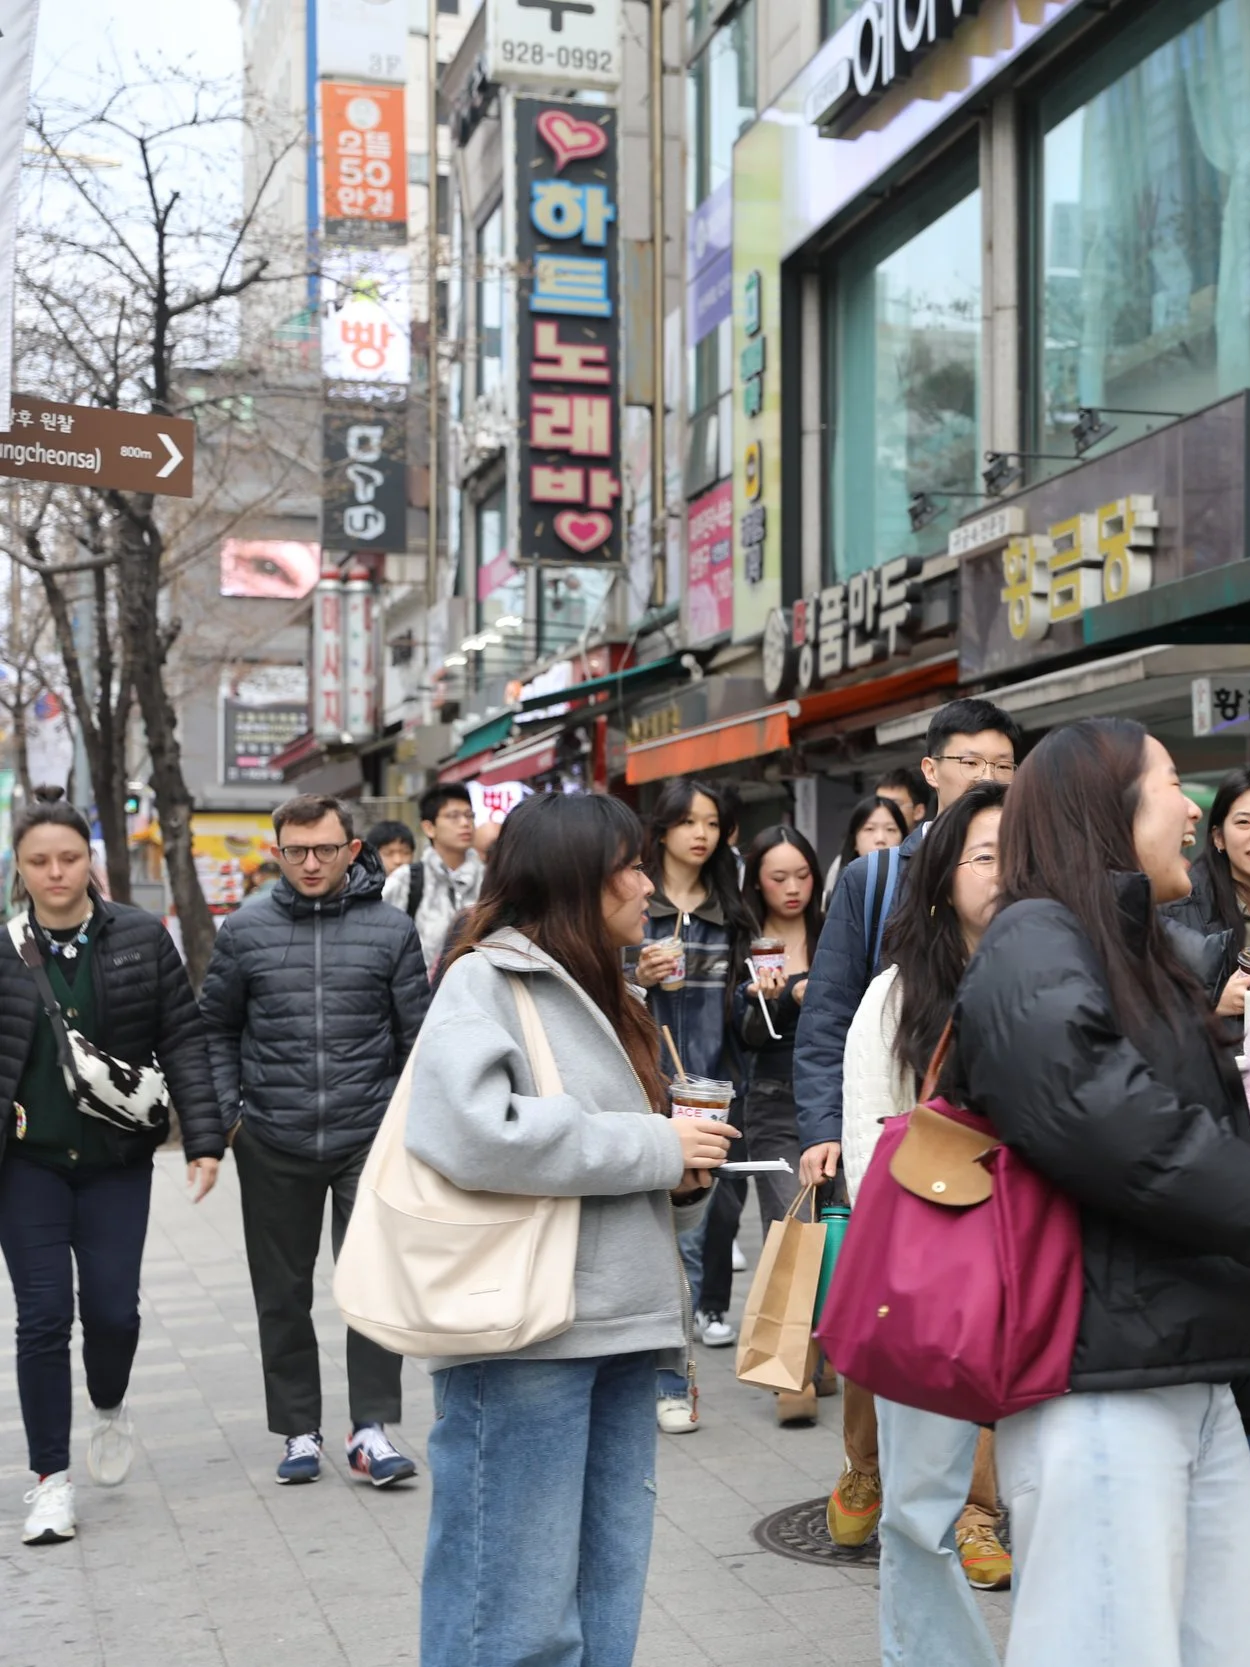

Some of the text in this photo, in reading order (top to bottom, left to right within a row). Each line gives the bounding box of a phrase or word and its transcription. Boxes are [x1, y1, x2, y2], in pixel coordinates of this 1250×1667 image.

[502, 41, 613, 73] 928-0992
[341, 319, 396, 370] 빵
[40, 412, 75, 434] 원찰
[120, 446, 152, 460] 800m
[1001, 494, 1140, 642] 황금당
[794, 557, 910, 690] 명품만두
